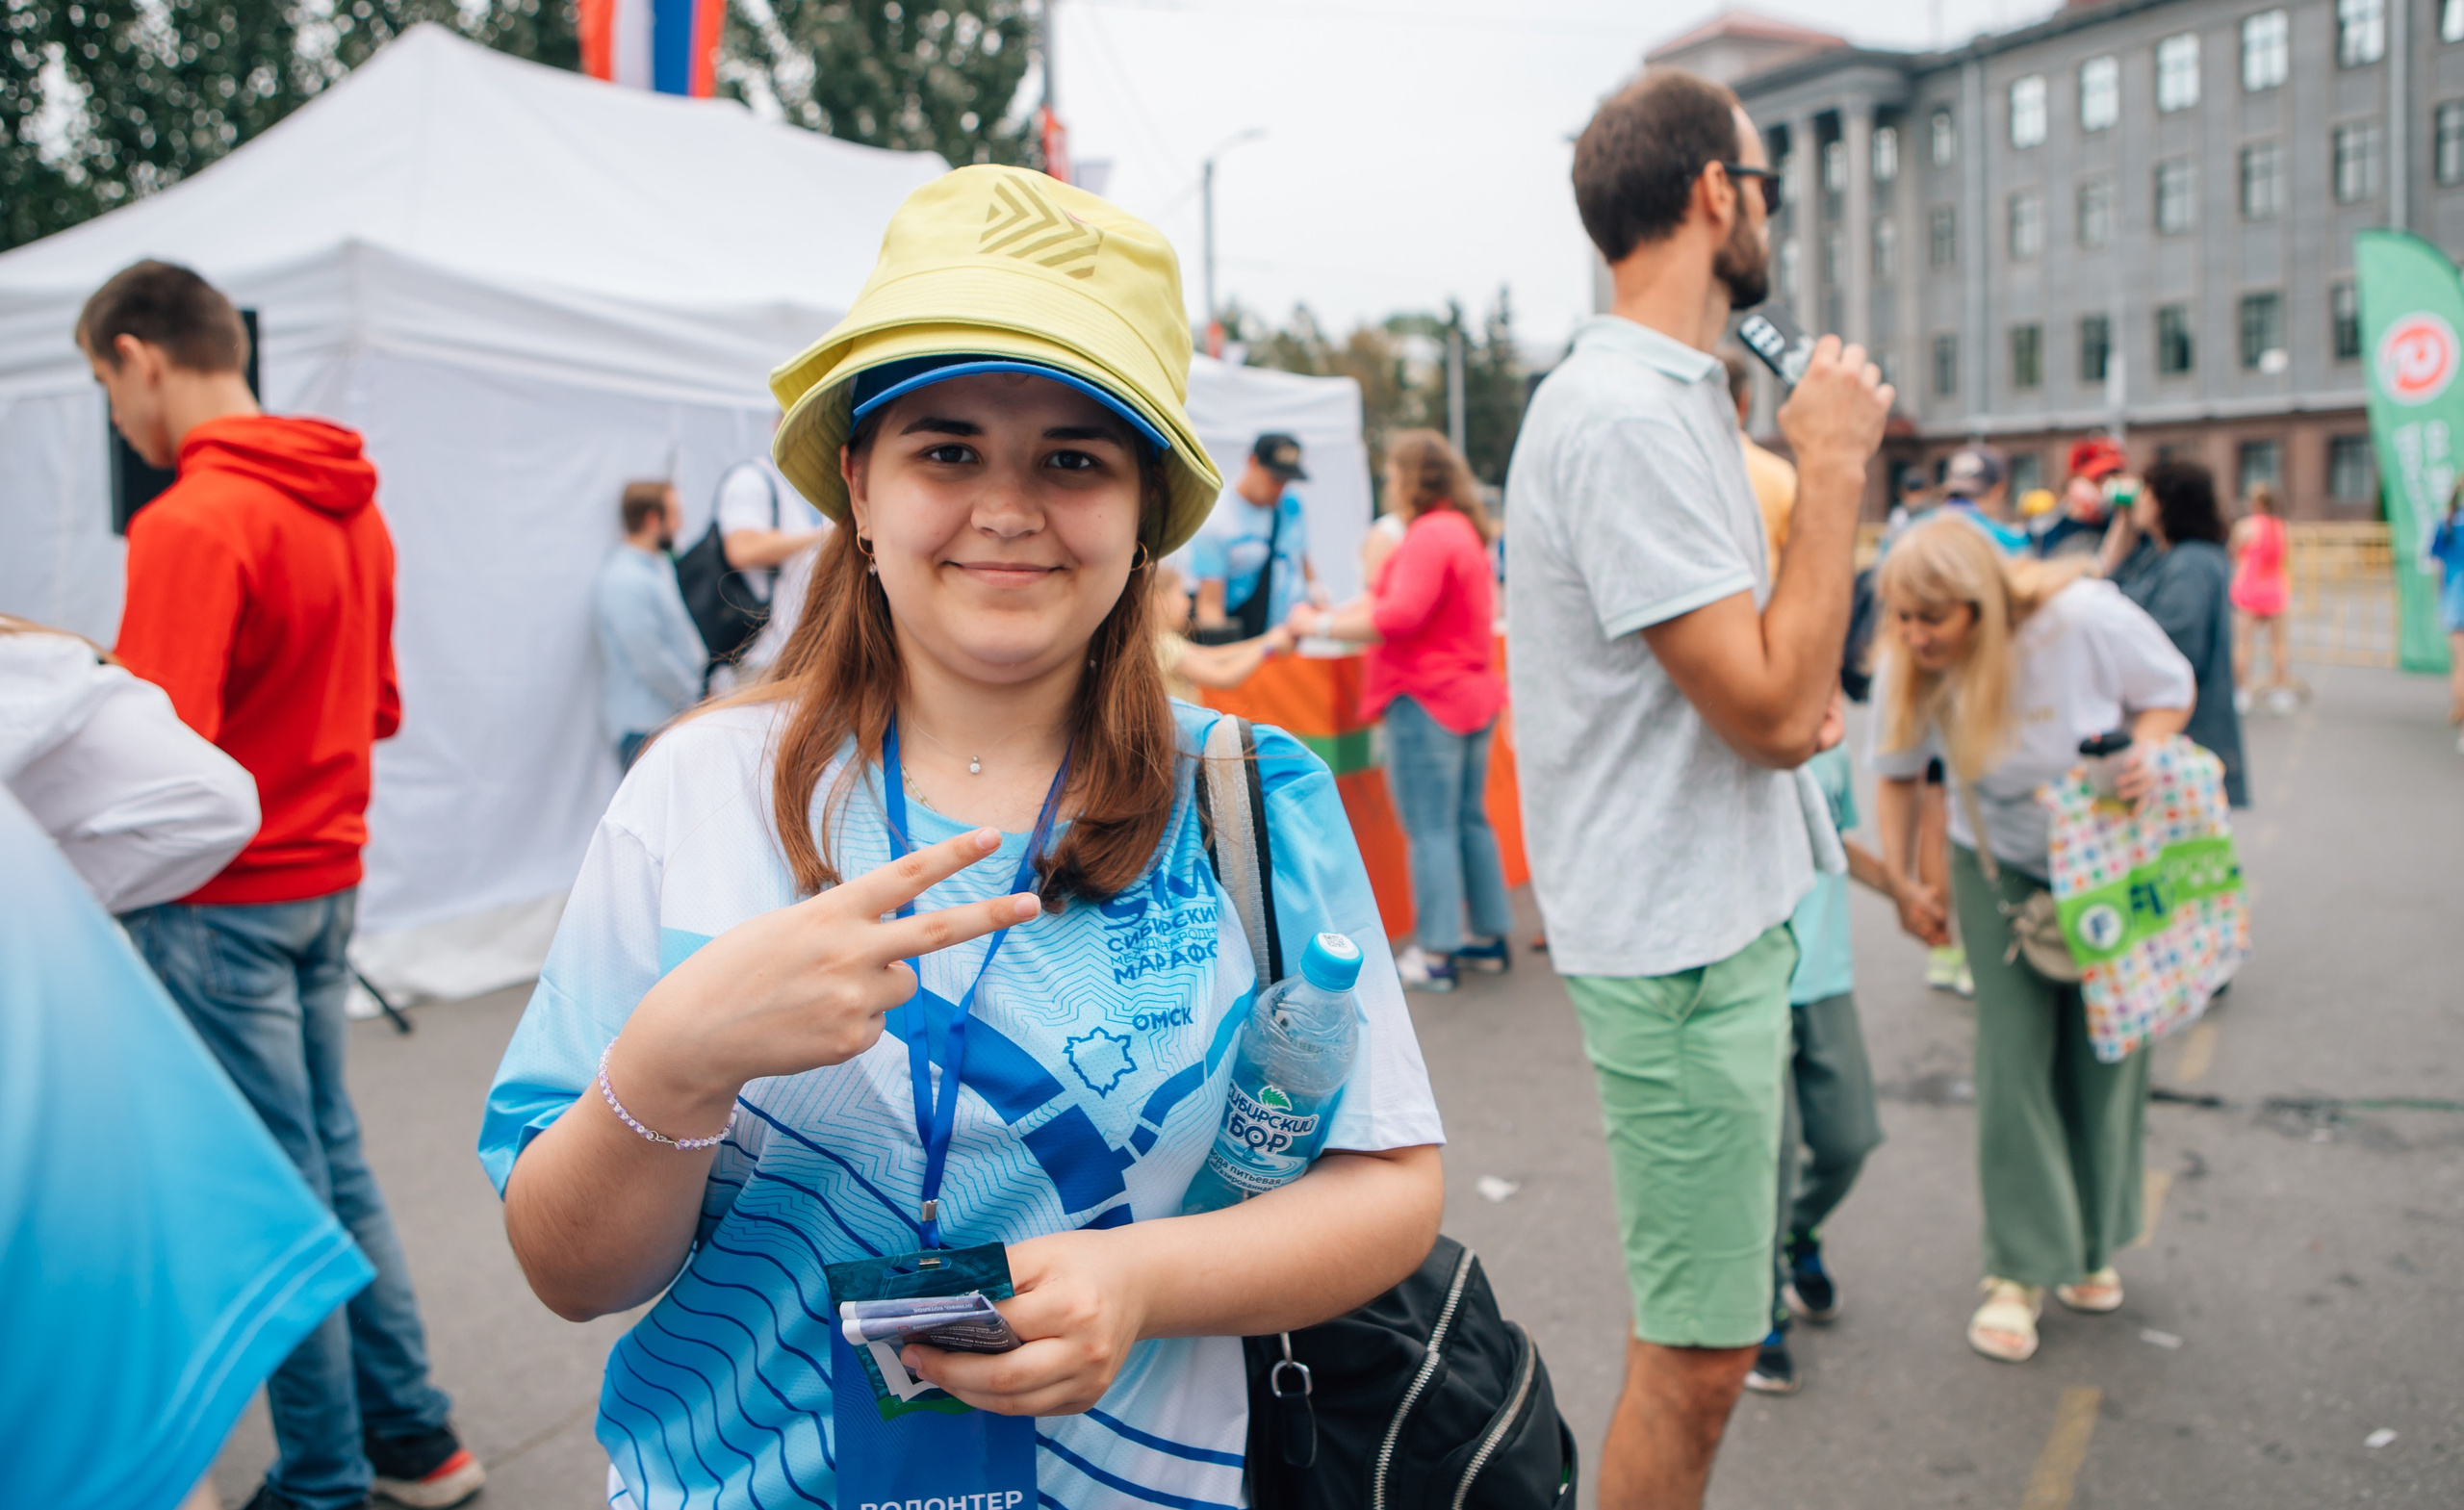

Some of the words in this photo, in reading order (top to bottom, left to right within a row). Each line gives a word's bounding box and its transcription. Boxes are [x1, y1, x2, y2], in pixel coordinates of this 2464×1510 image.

[1107, 906, 1218, 952] СИБИРСКИ
[1133, 1007, 1194, 1031] ОМСК
[1229, 1113, 1288, 1153] БОР
[1230, 1165, 1282, 1186] питьевая
